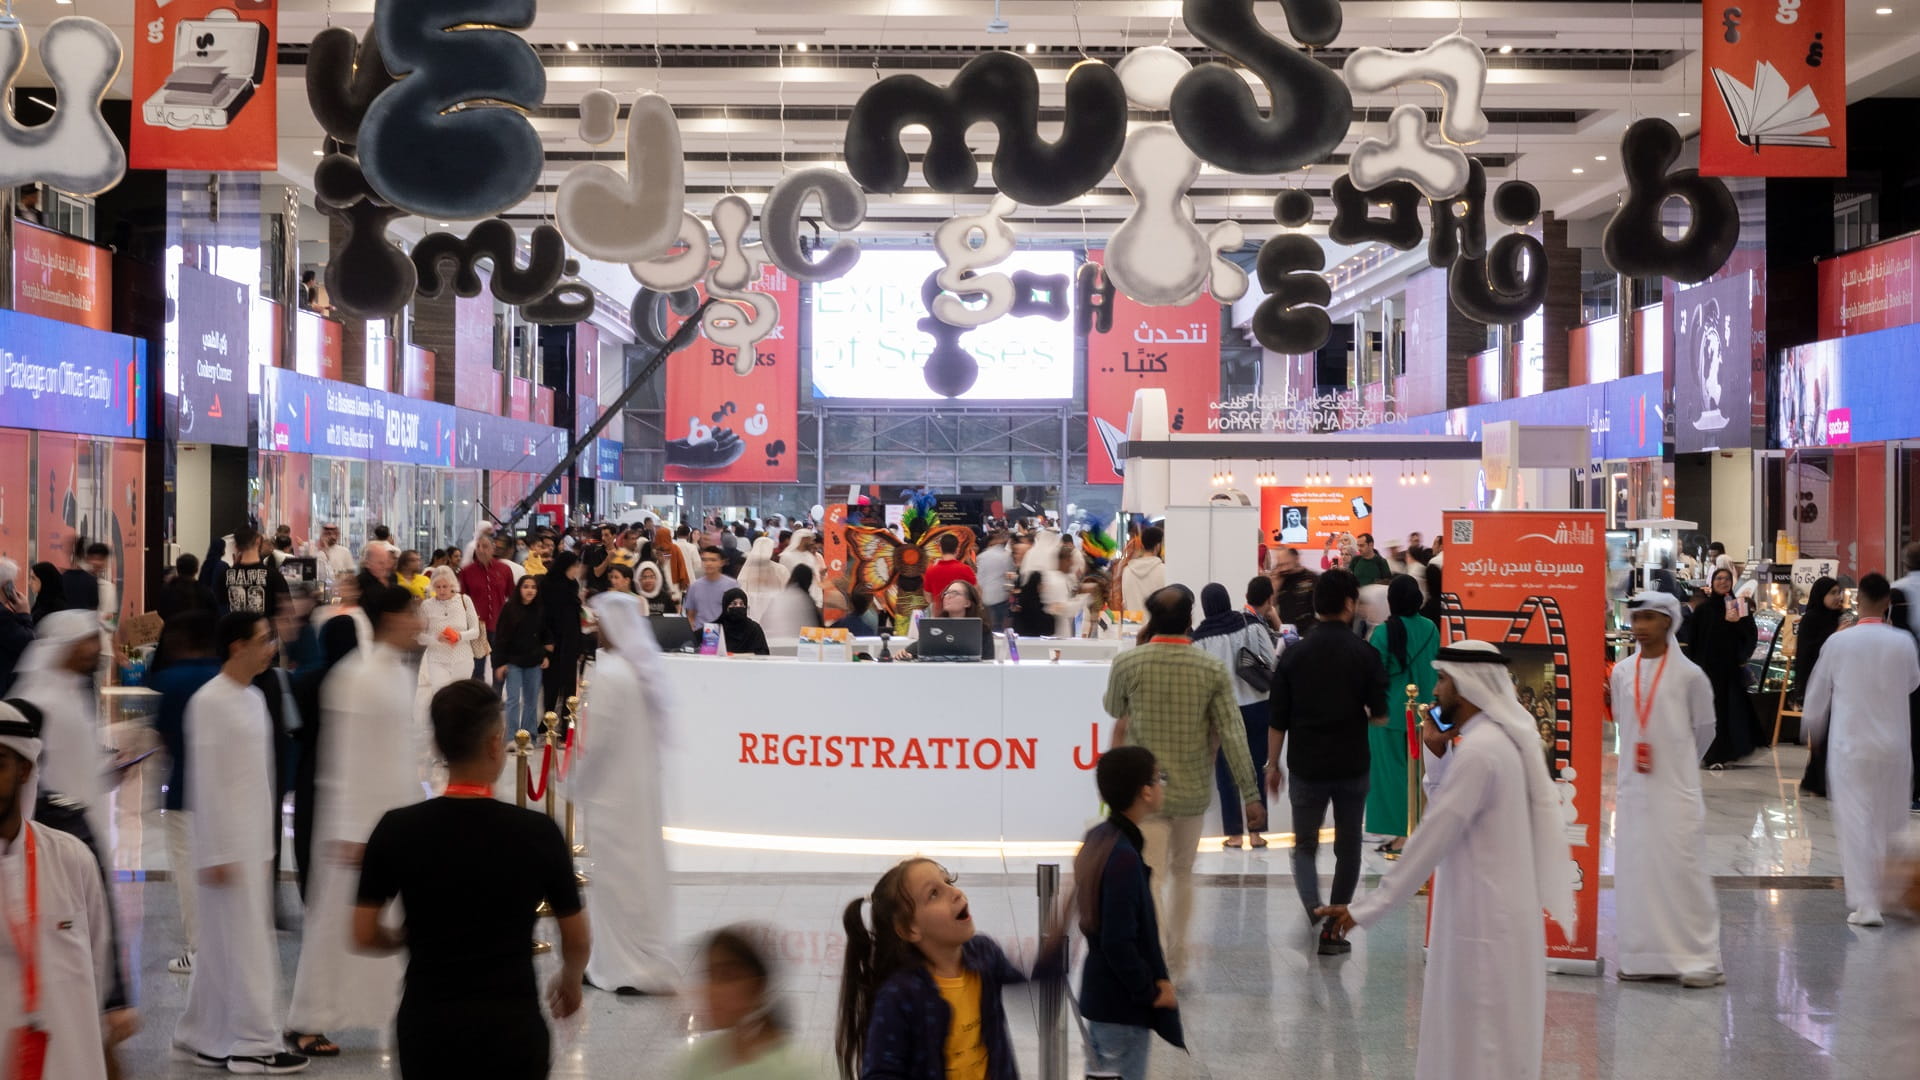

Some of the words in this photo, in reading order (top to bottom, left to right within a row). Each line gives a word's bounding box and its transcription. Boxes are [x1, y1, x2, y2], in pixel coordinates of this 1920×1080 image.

[1857, 293, 1889, 316] International
[1133, 320, 1208, 344] نتحدث
[711, 348, 776, 367] Boks
[876, 330, 1054, 369] Seses
[4, 352, 46, 399] Package
[46, 367, 59, 394] on
[59, 360, 84, 398] Office
[84, 365, 112, 409] Facility
[196, 358, 217, 384] Cookery
[217, 362, 233, 382] Corner
[385, 408, 400, 447] AED
[1342, 410, 1408, 426] STATION
[1460, 558, 1498, 577] باركود
[1500, 560, 1531, 577] سجن
[1534, 559, 1585, 578] مسرحية
[1794, 573, 1803, 584] To
[1804, 573, 1816, 584] Go
[738, 732, 1039, 771] REGISTRATION
